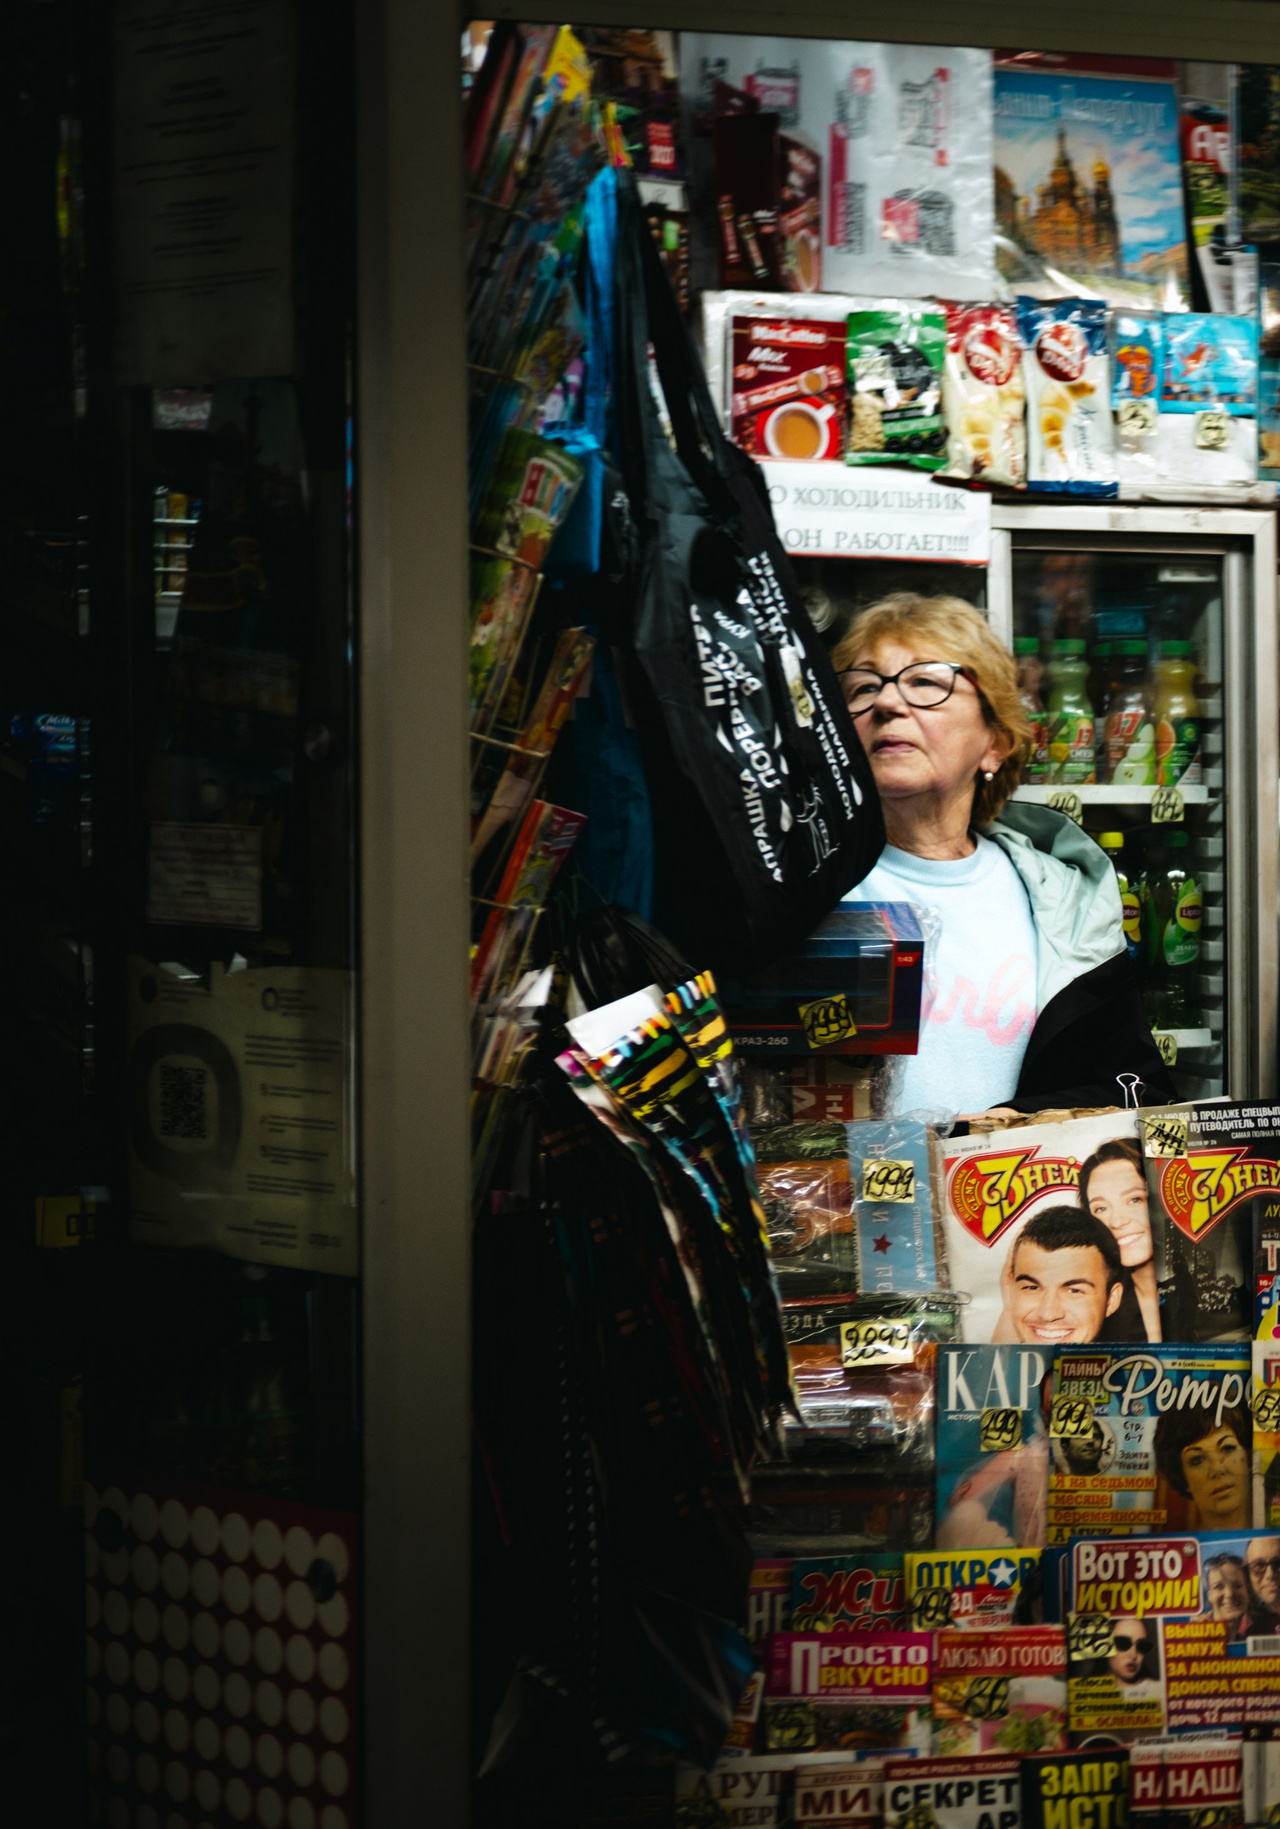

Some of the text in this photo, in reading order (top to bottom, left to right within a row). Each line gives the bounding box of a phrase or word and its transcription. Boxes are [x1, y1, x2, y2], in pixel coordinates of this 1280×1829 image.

[793, 486, 967, 512] ХОЛОДИЛЬНИК
[783, 528, 970, 553] ОН РАБОТАЕТ!!!!
[1200, 1107, 1240, 1121] ПРОДАЖЕ
[1189, 1117, 1271, 1132] ПУТЕВОДИТЕЛЬ ПО
[1053, 1476, 1156, 1490] Я на седьмом
[1053, 1493, 1109, 1507] месяце
[1053, 1510, 1167, 1526] беременности,
[1164, 1623, 1227, 1639] ВЫШЛА
[1165, 1641, 1226, 1658] ЗАМУЖ
[820, 1665, 930, 1688] ВКУСНО
[1166, 1662, 1188, 1677] ЗА
[1167, 1679, 1230, 1698] ДОНОРА
[1203, 1710, 1218, 1724] 12
